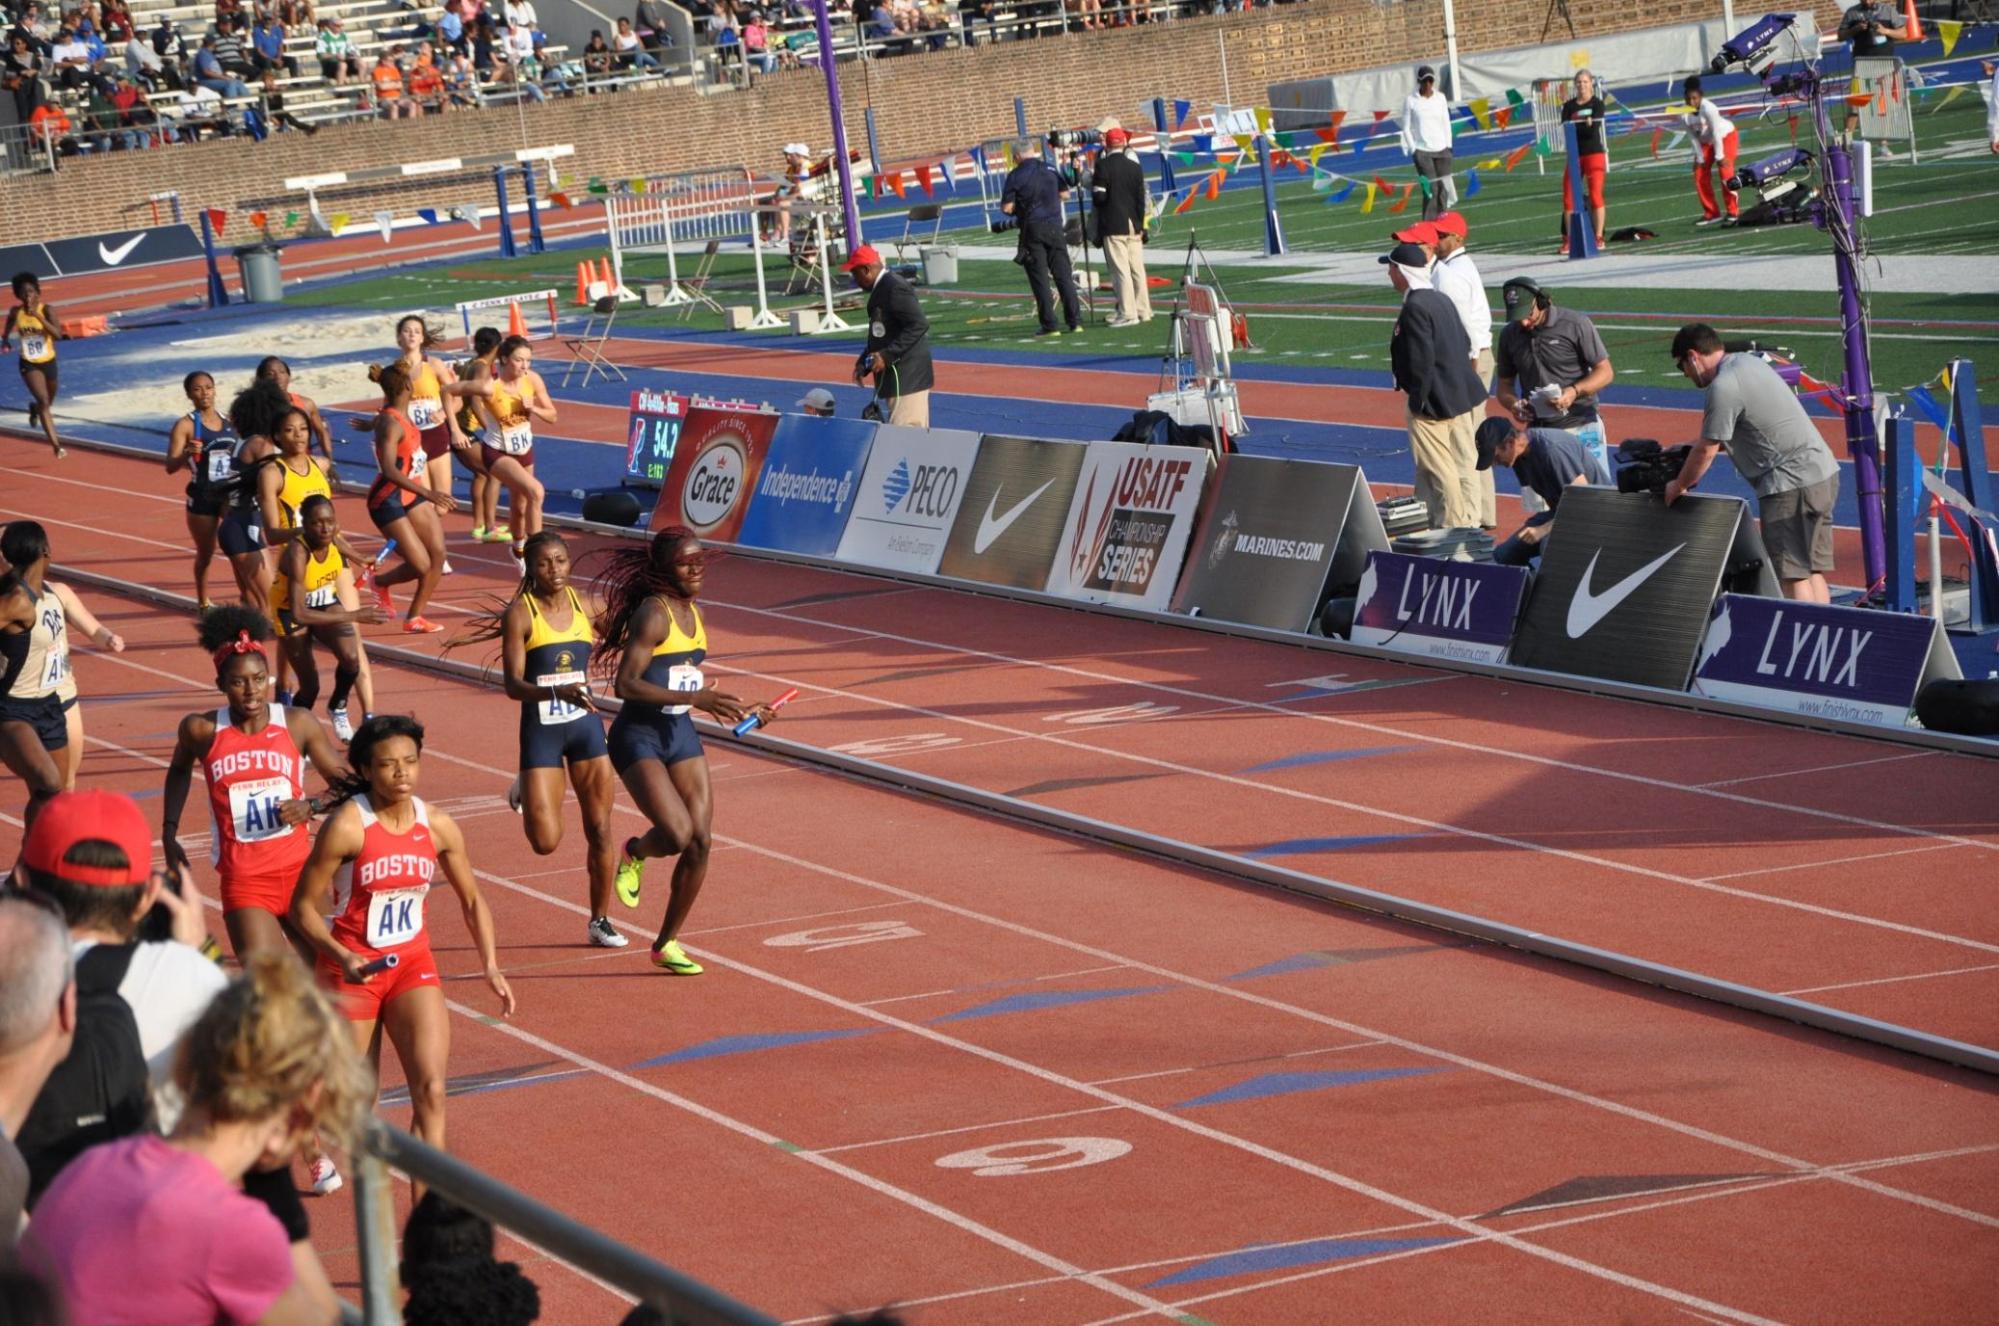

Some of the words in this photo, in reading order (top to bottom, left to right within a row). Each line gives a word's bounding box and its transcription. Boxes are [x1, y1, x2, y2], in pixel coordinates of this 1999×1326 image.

[1755, 27, 1774, 42] LYNX
[1772, 157, 1793, 170] LYNX
[511, 432, 528, 452] BK
[690, 465, 736, 505] Grace
[761, 463, 838, 507] Independence
[906, 464, 958, 519] PECO
[1118, 457, 1192, 510] USATF
[1109, 518, 1166, 545] CHAMPIONSHIP
[1234, 533, 1325, 563] MARINES.COM
[1097, 543, 1154, 585] SERIES
[1396, 562, 1481, 631] LYNX
[1756, 610, 1874, 687] LYNX
[210, 749, 294, 784] BOSTON
[245, 795, 284, 833] AK
[378, 898, 414, 937] AK
